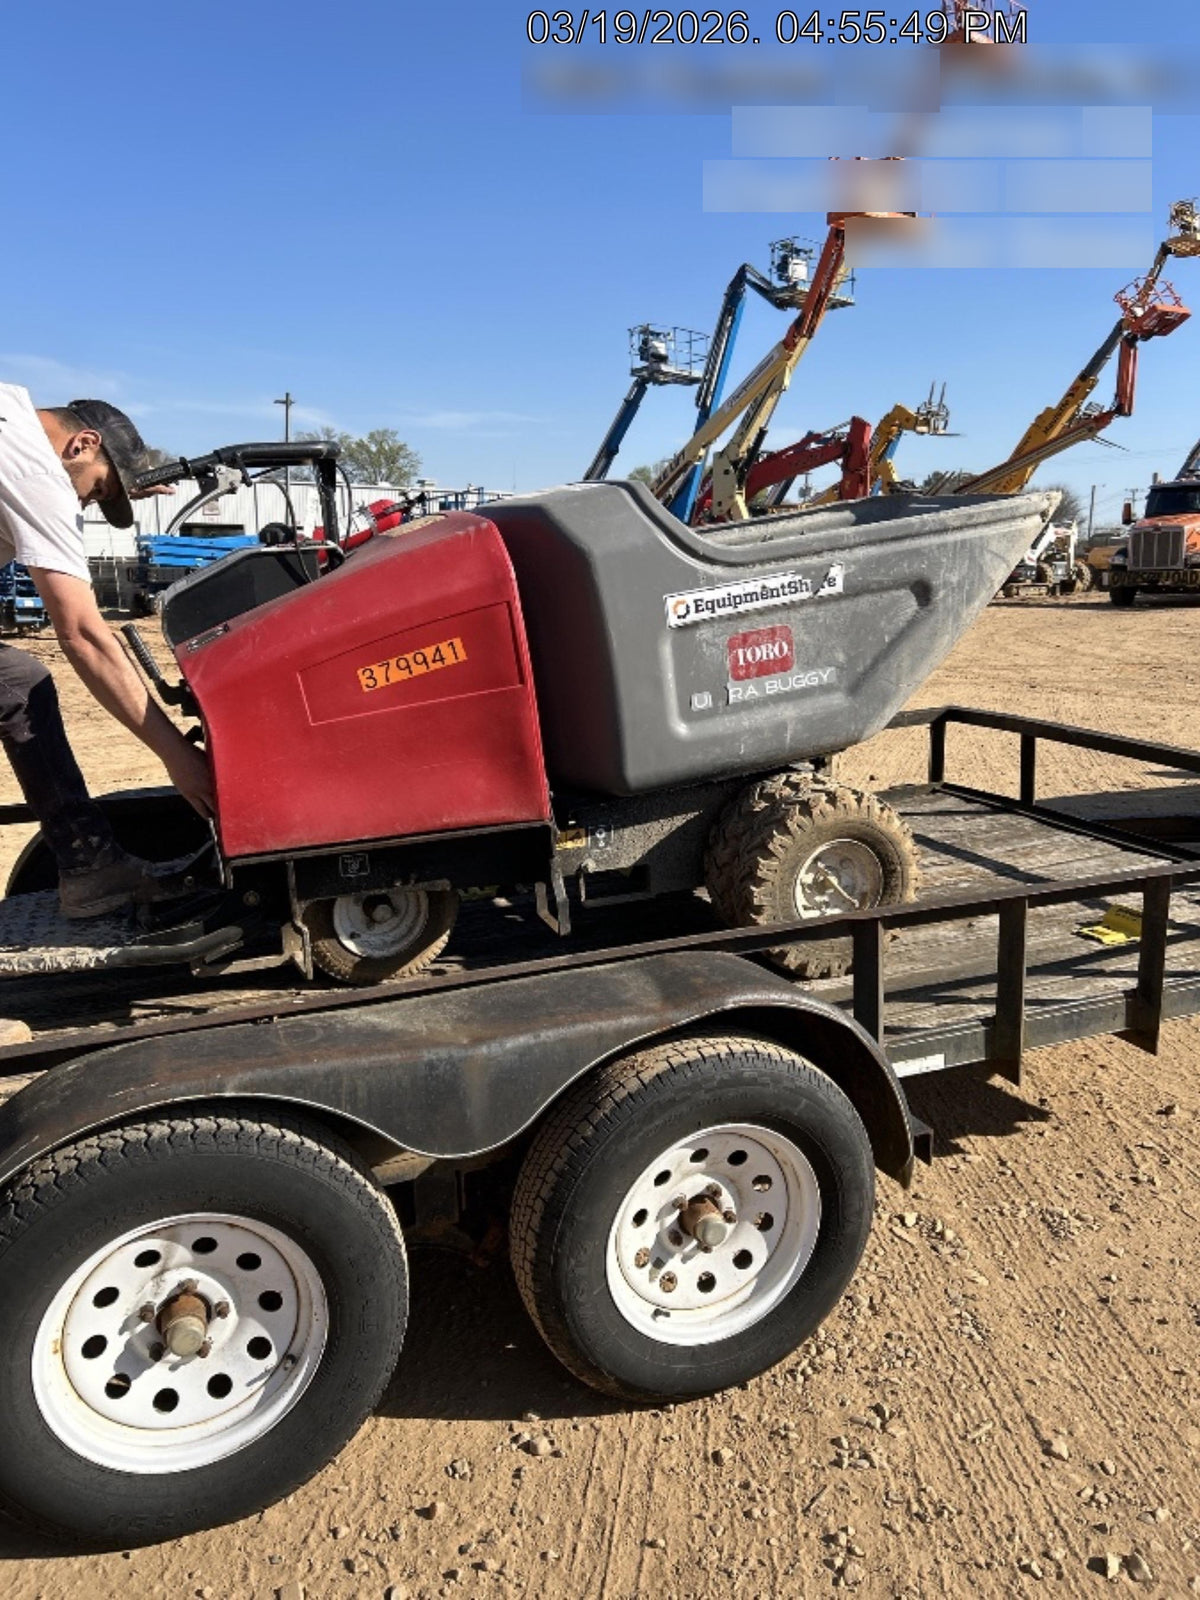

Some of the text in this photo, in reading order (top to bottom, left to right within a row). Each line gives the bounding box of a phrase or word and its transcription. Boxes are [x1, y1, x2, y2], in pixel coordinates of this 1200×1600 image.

[693, 576, 836, 614] EquipmentShe
[362, 641, 459, 689] 379941
[735, 641, 789, 666] TORO
[694, 667, 834, 709] URA BUGGY
